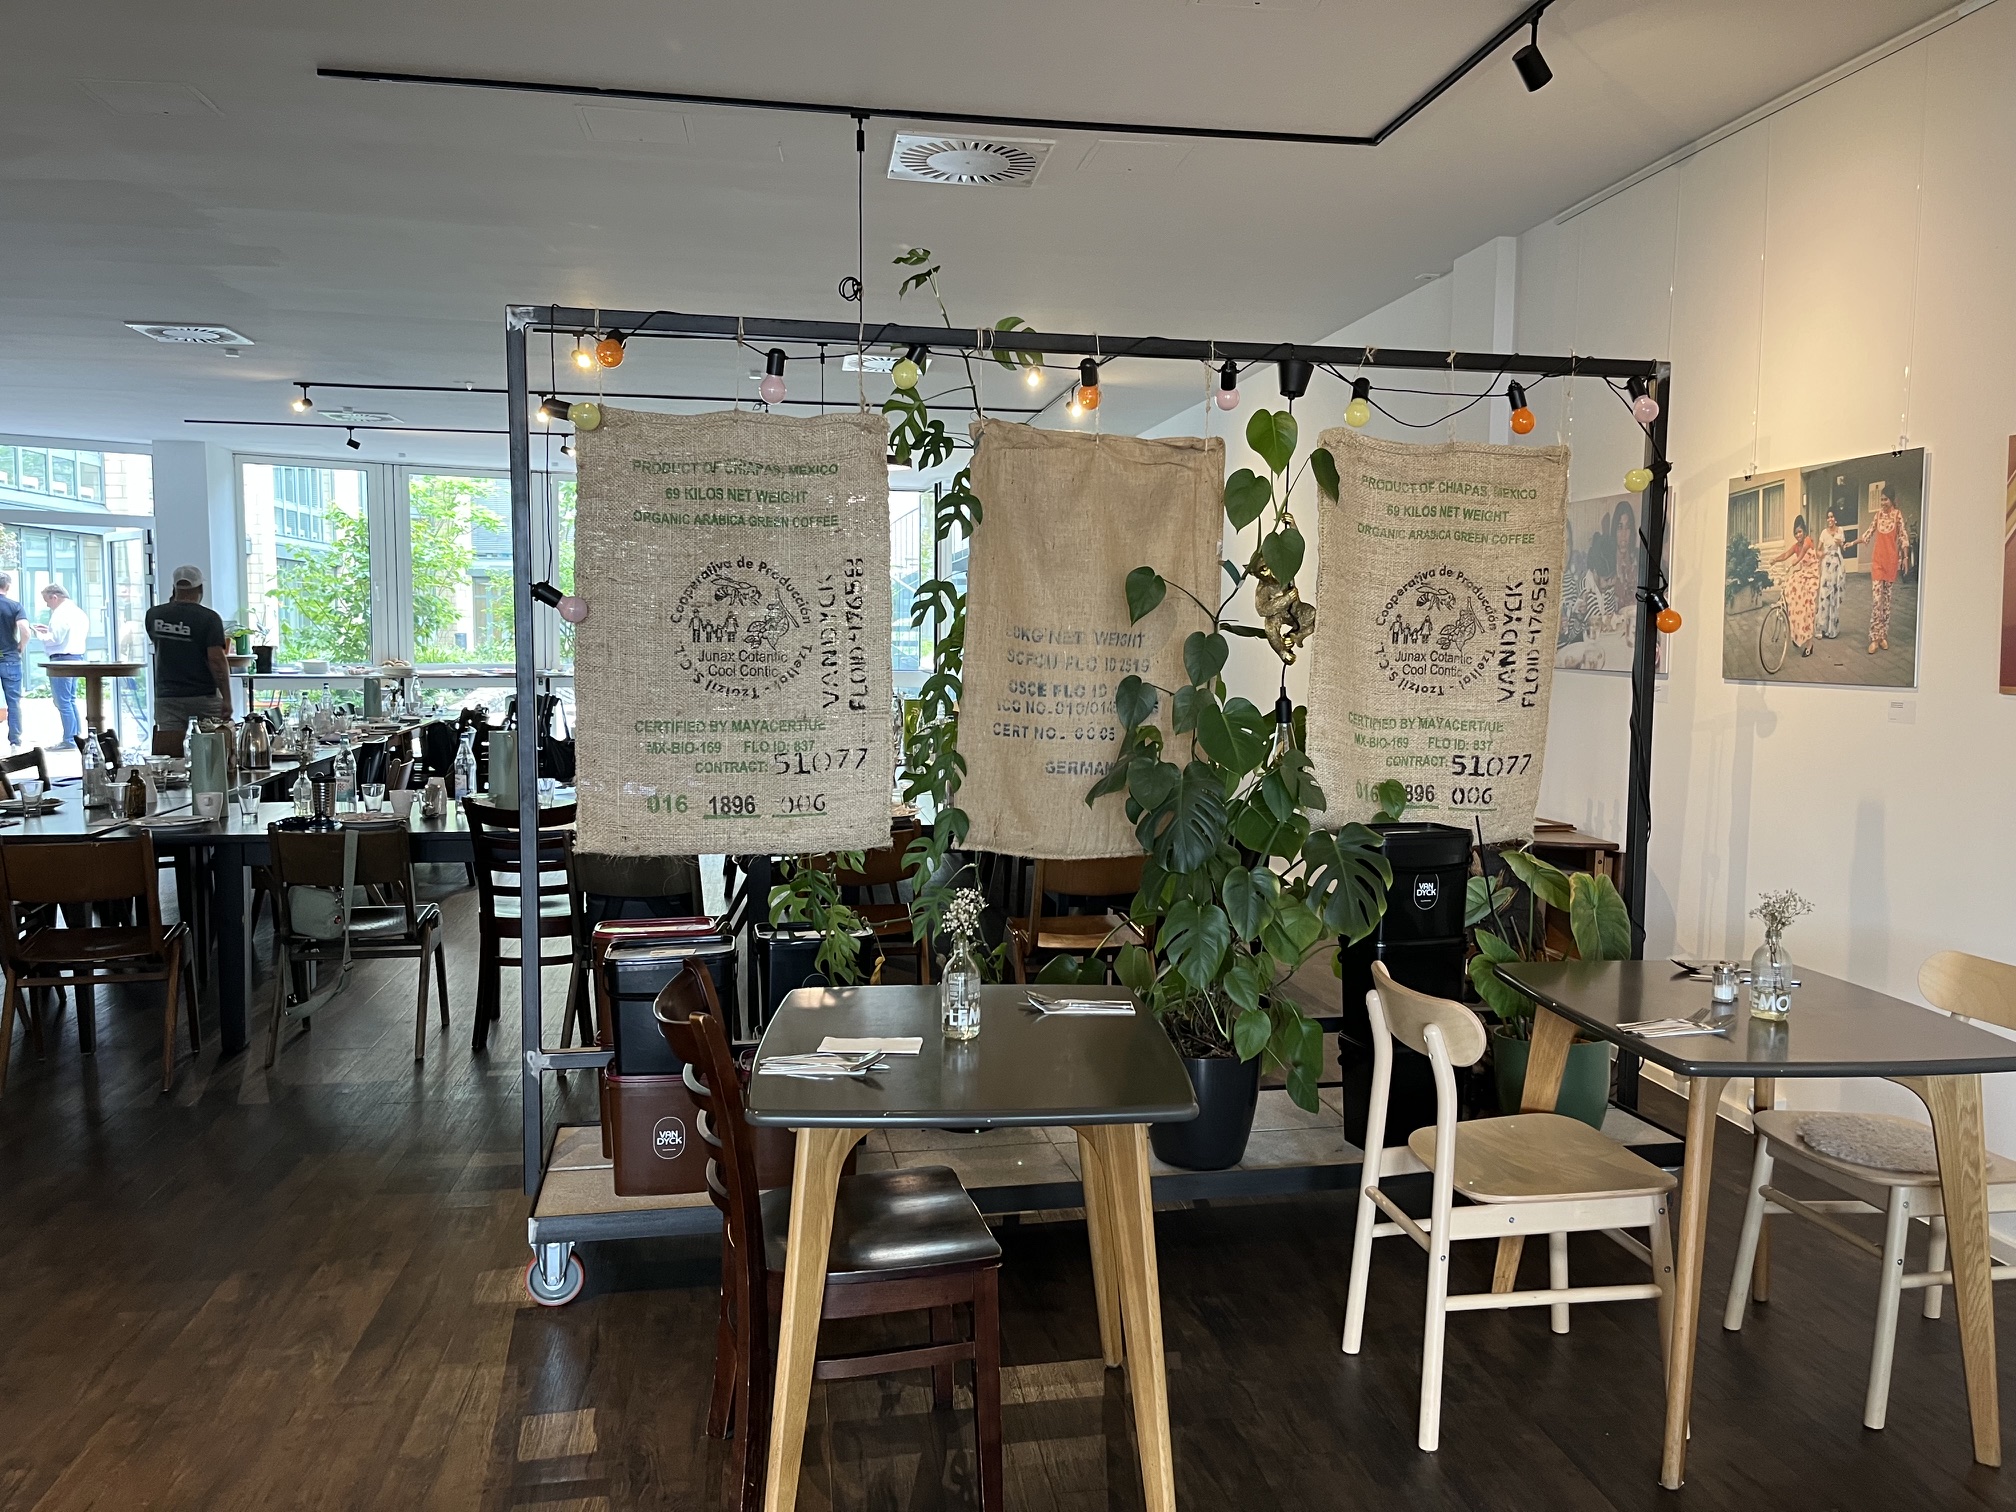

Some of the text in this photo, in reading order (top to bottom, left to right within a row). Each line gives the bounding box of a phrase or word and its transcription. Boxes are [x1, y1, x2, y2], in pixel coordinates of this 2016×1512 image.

[632, 460, 698, 475] PRODUCT
[703, 461, 722, 474] OF
[788, 464, 839, 475] MEXICO
[1361, 475, 1417, 493] PRODUCT
[1419, 481, 1435, 493] OF
[665, 487, 808, 504] 69 KILOS NET WEIGHT
[633, 510, 839, 528] ORGANIC ARABICA GREEN COFFEE
[1387, 505, 1510, 522] 69 KILOS NET WEIGHT
[1357, 522, 1536, 545] ORGANIC ARABICA GREEN COFFEE
[670, 560, 733, 624] Cooperativa
[736, 556, 754, 569] de
[1375, 568, 1436, 627] Cooperativa
[1439, 565, 1453, 577] de
[698, 650, 735, 662] Junax
[1394, 650, 1427, 662] Junax
[740, 664, 779, 677] Contic
[1402, 664, 1427, 676] Cool
[1397, 678, 1445, 696] Tzotzil
[634, 720, 705, 733] CERTIFIED
[709, 720, 727, 733] BY
[1348, 711, 1397, 731] CERTIFIED
[1400, 719, 1417, 730] BY
[993, 722, 1028, 739] CERT
[743, 740, 770, 753] FLO
[793, 740, 815, 752] 837
[1354, 732, 1409, 749] MX-BIO-169
[1428, 737, 1451, 749] FLO
[1473, 740, 1494, 751] 837
[1045, 761, 1116, 776] GERMAN
[1451, 753, 1532, 777] 51077
[1404, 784, 1435, 803] 896
[1451, 787, 1492, 805] 006
[647, 794, 688, 813] 016
[708, 794, 757, 815] 1896
[1416, 888, 1437, 897] DYCK
[1418, 882, 1435, 891] VAN
[656, 1136, 683, 1146] DYCK
[658, 1130, 679, 1139] VAN
